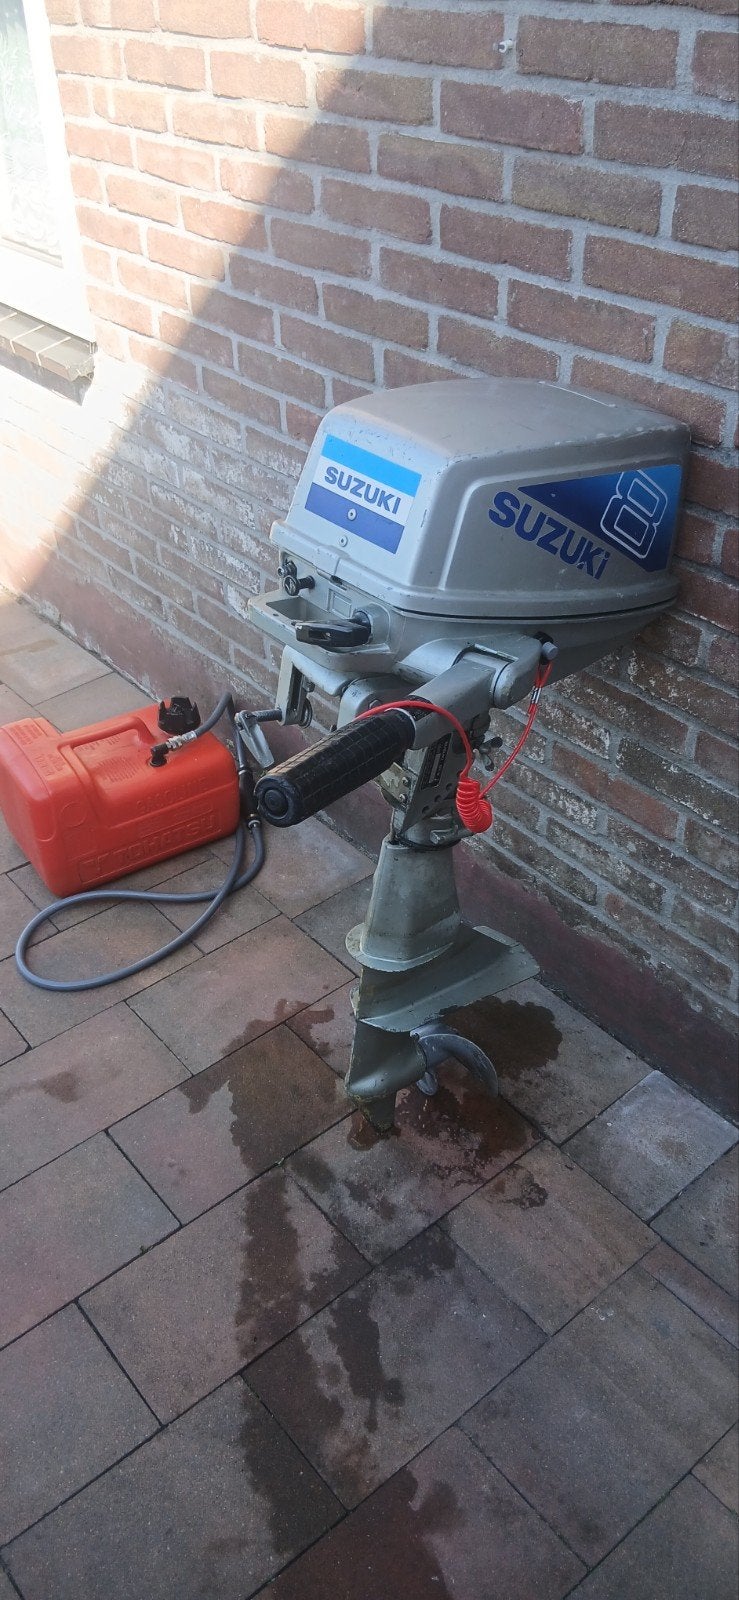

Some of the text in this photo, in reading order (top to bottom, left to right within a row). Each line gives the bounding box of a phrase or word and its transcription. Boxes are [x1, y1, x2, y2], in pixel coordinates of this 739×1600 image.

[324, 466, 402, 515] SUZUKI
[600, 469, 668, 559] 8
[488, 491, 611, 580] SUZUKI
